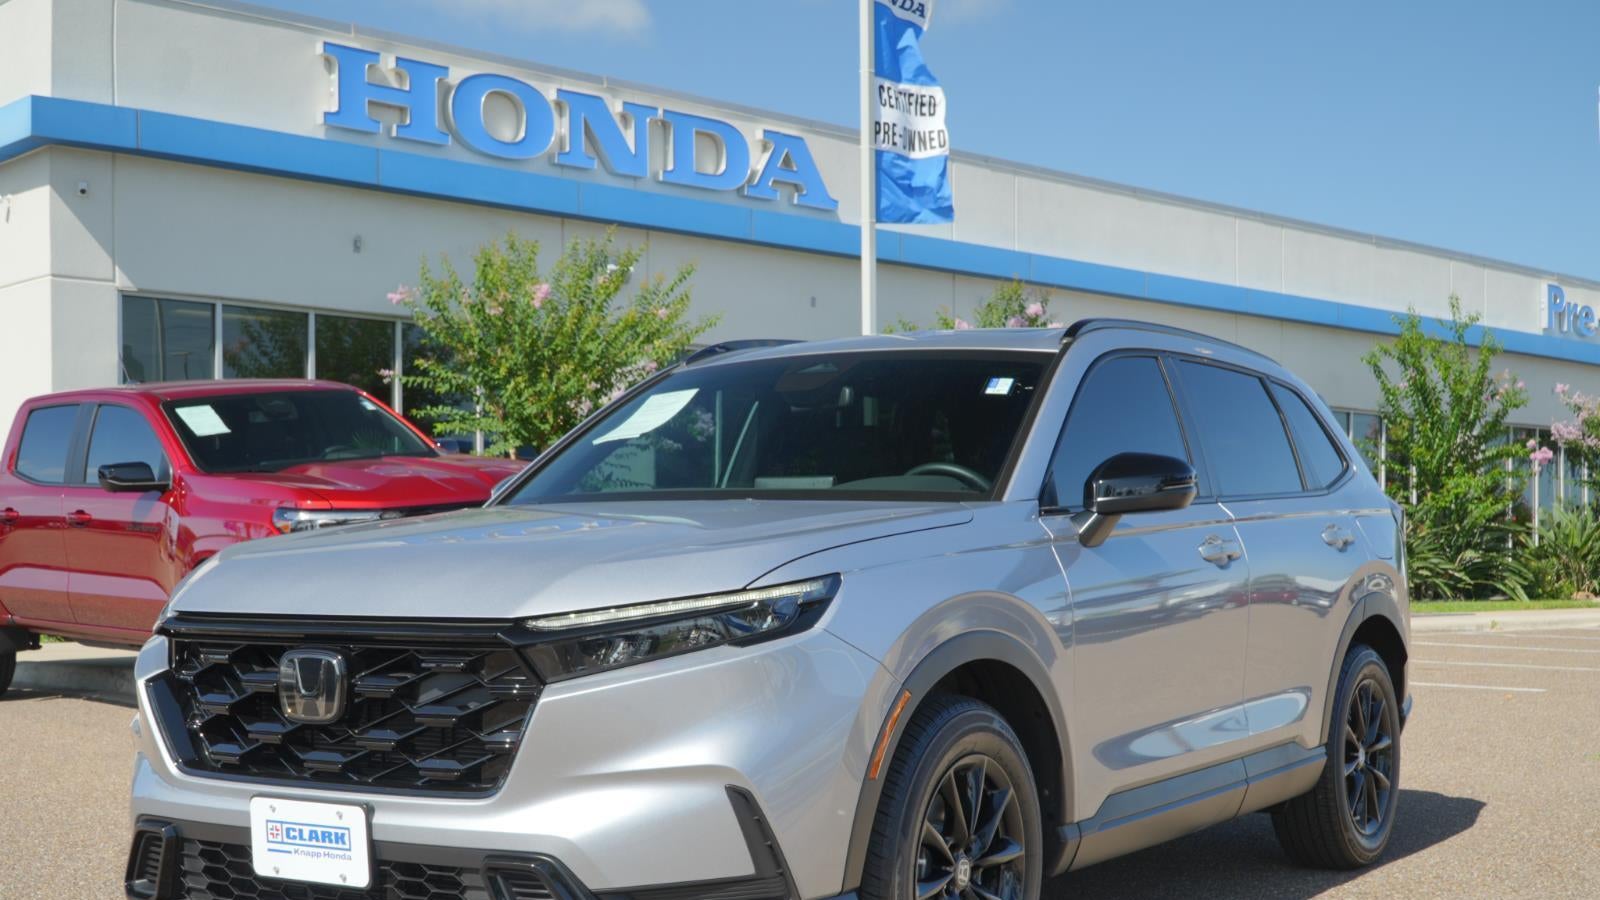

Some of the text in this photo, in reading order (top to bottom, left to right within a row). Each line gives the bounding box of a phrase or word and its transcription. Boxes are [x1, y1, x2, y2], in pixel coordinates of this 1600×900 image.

[878, 84, 937, 118] CERTIFIED
[319, 40, 839, 210] HONDA
[874, 121, 947, 153] PRE-OWNED
[1545, 282, 1600, 337] Pre
[285, 826, 347, 846] CLARK
[293, 847, 352, 862] Knapp Honda
